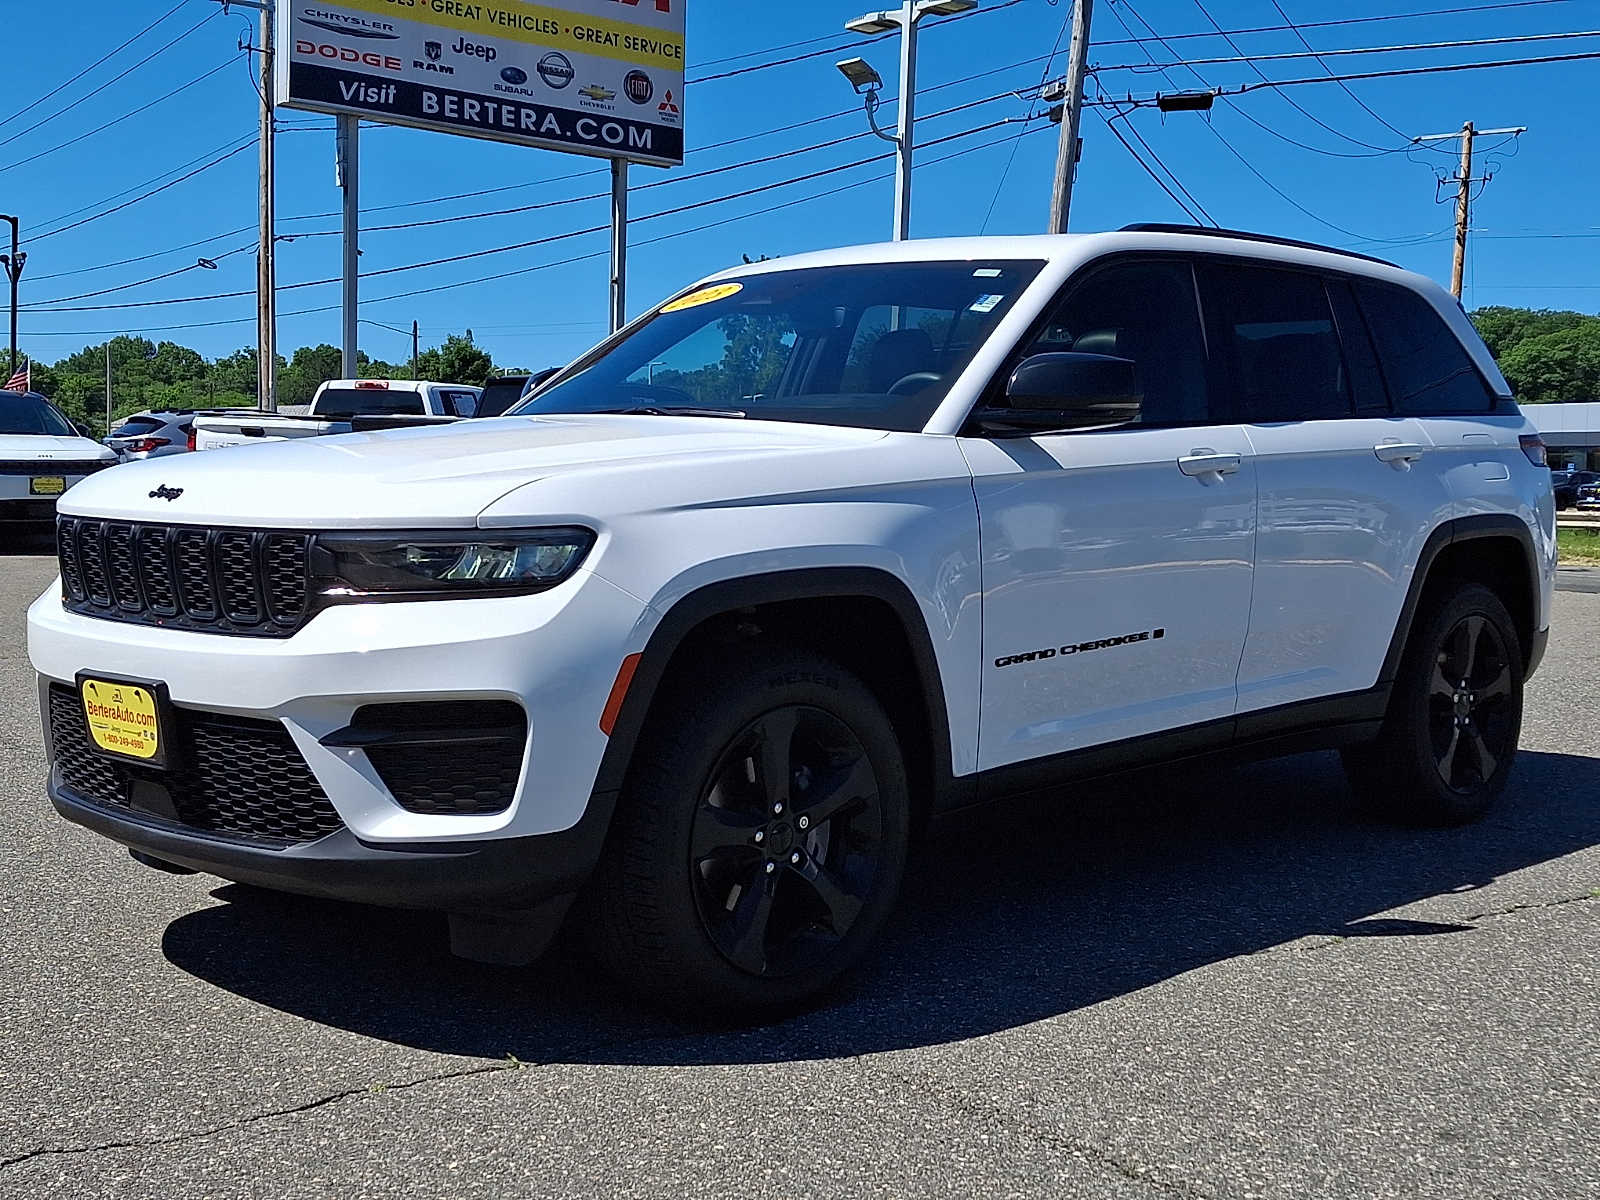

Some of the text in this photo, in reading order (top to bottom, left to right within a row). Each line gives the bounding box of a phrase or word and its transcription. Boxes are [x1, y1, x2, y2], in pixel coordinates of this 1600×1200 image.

[304, 8, 395, 32] CHRYSLER
[431, 0, 681, 59] GREAT VEHICLES GREAT SERVICE
[296, 40, 402, 71] DODGE
[452, 36, 497, 62] Jeep
[412, 60, 455, 75] RAM
[493, 83, 534, 97] SUBARU
[631, 79, 649, 98] FIAT
[338, 80, 652, 149] Visit BERTERA.COM
[579, 99, 616, 111] CHEVROLET
[994, 631, 1150, 669] GRAND CHEROKEE
[86, 699, 156, 728] BerteraAuto.com
